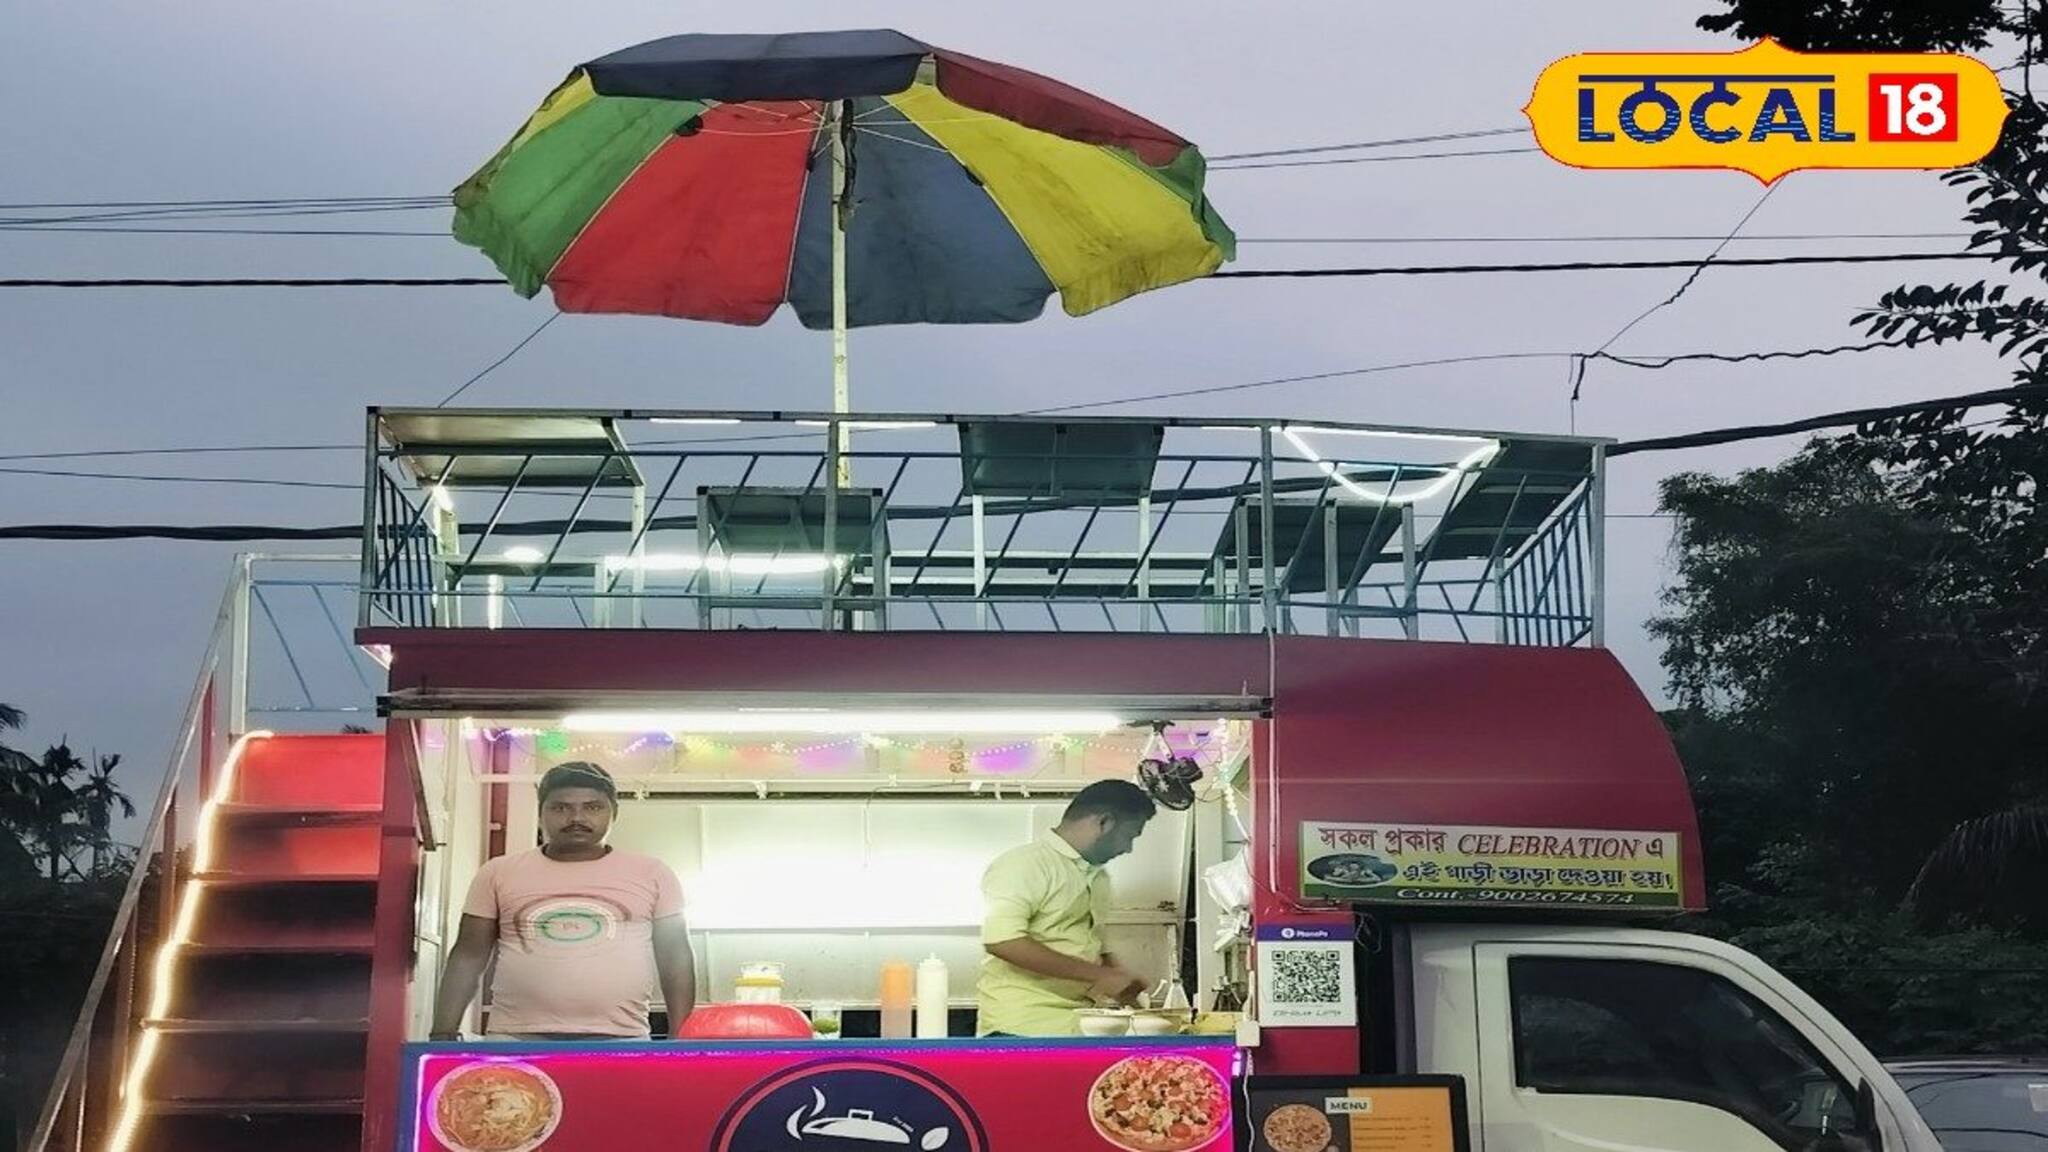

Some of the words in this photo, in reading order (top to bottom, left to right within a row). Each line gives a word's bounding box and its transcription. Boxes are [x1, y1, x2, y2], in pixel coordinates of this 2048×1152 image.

[1318, 828, 1377, 850] সকল
[1385, 828, 1447, 855] প্রকার
[1458, 834, 1641, 859] CELEBRATION
[1646, 838, 1664, 858] এ
[1403, 861, 1440, 882] এই
[1499, 866, 1553, 887] ভাড়া
[1330, 1101, 1368, 1110] MENU
